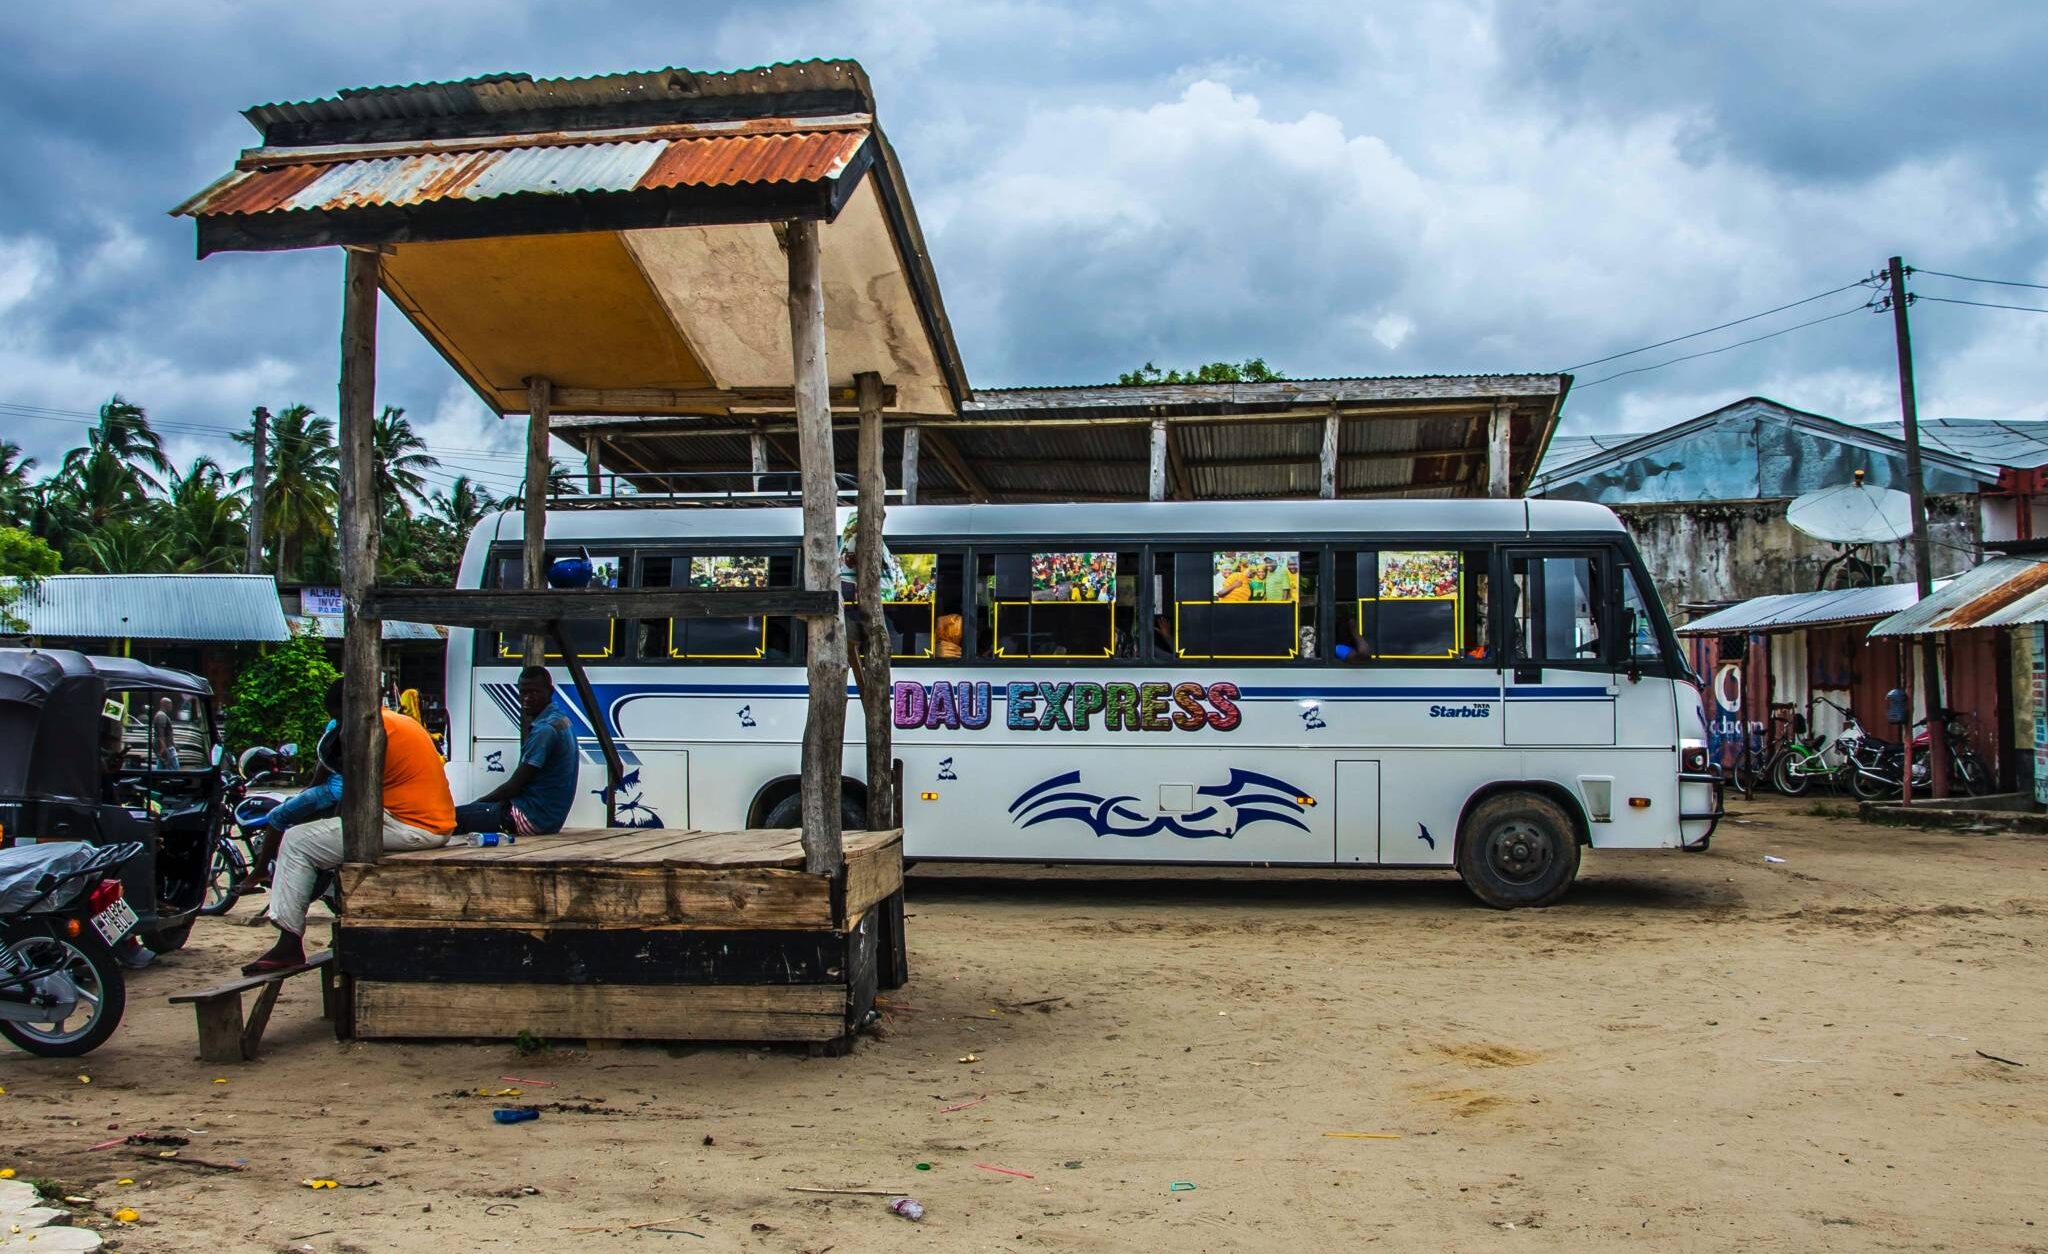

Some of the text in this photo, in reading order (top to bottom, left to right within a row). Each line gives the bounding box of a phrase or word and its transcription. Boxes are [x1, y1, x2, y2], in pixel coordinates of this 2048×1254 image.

[894, 681, 1242, 731] DAU EXPRESS
[1429, 705, 1490, 718] Starbus
